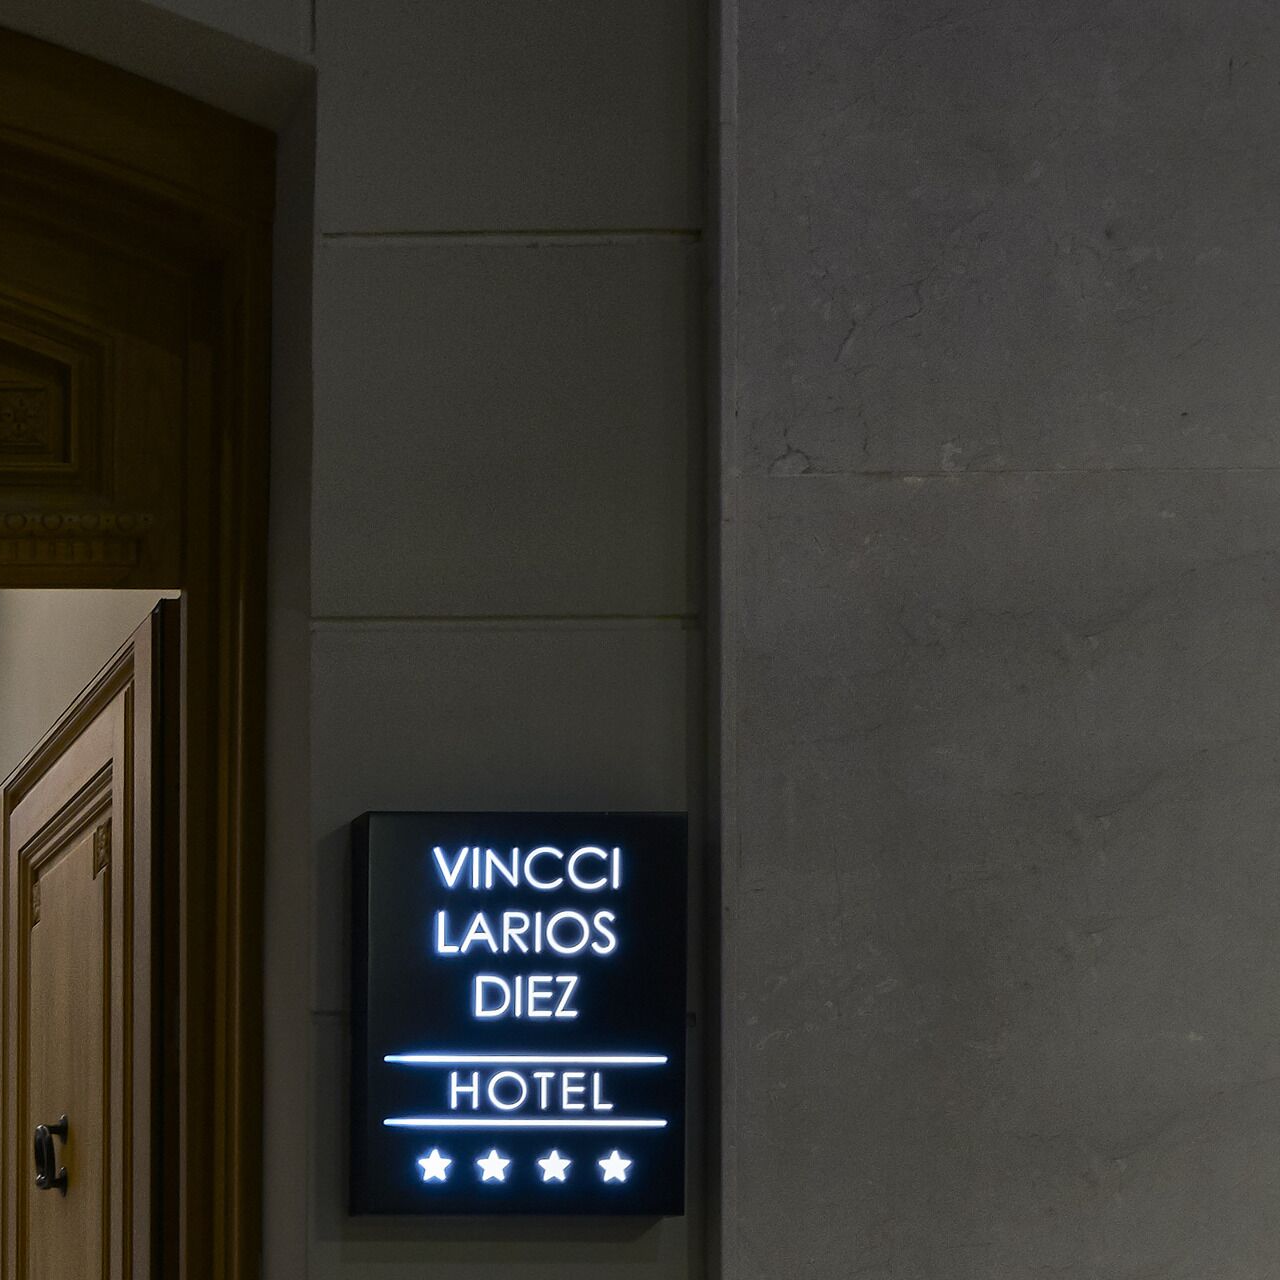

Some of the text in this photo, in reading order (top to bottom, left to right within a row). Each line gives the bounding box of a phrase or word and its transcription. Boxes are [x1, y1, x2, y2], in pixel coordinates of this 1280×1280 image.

[433, 846, 621, 890] VINCCI
[436, 910, 617, 955] LARIOS
[474, 975, 579, 1018] DIEZ
[450, 1070, 614, 1111] HOTEL
